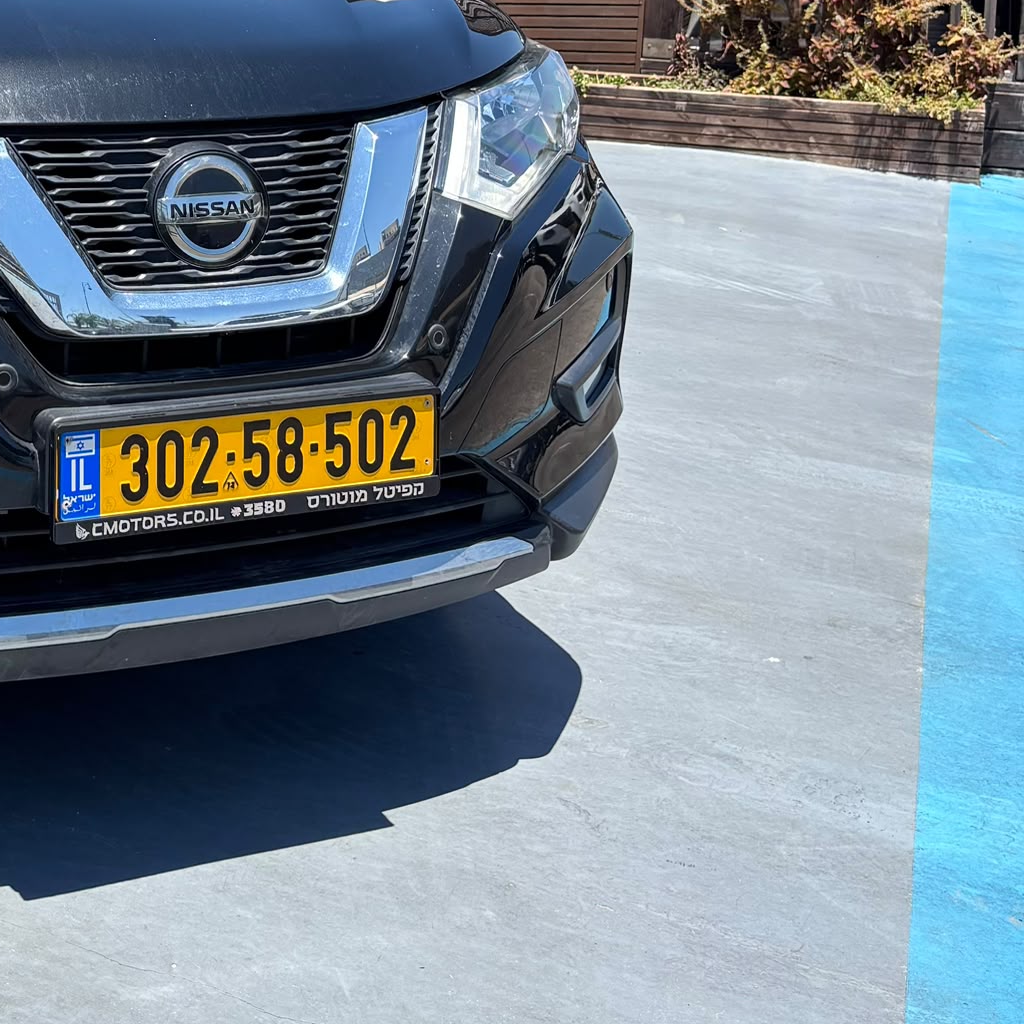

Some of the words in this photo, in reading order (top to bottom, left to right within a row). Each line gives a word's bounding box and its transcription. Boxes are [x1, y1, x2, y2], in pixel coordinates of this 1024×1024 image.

[170, 199, 255, 219] NISSAN
[71, 458, 93, 492] IL
[306, 488, 368, 509] מוטורס
[373, 482, 425, 501] קפיטל
[92, 507, 225, 537] CMOTORS.CO.IL
